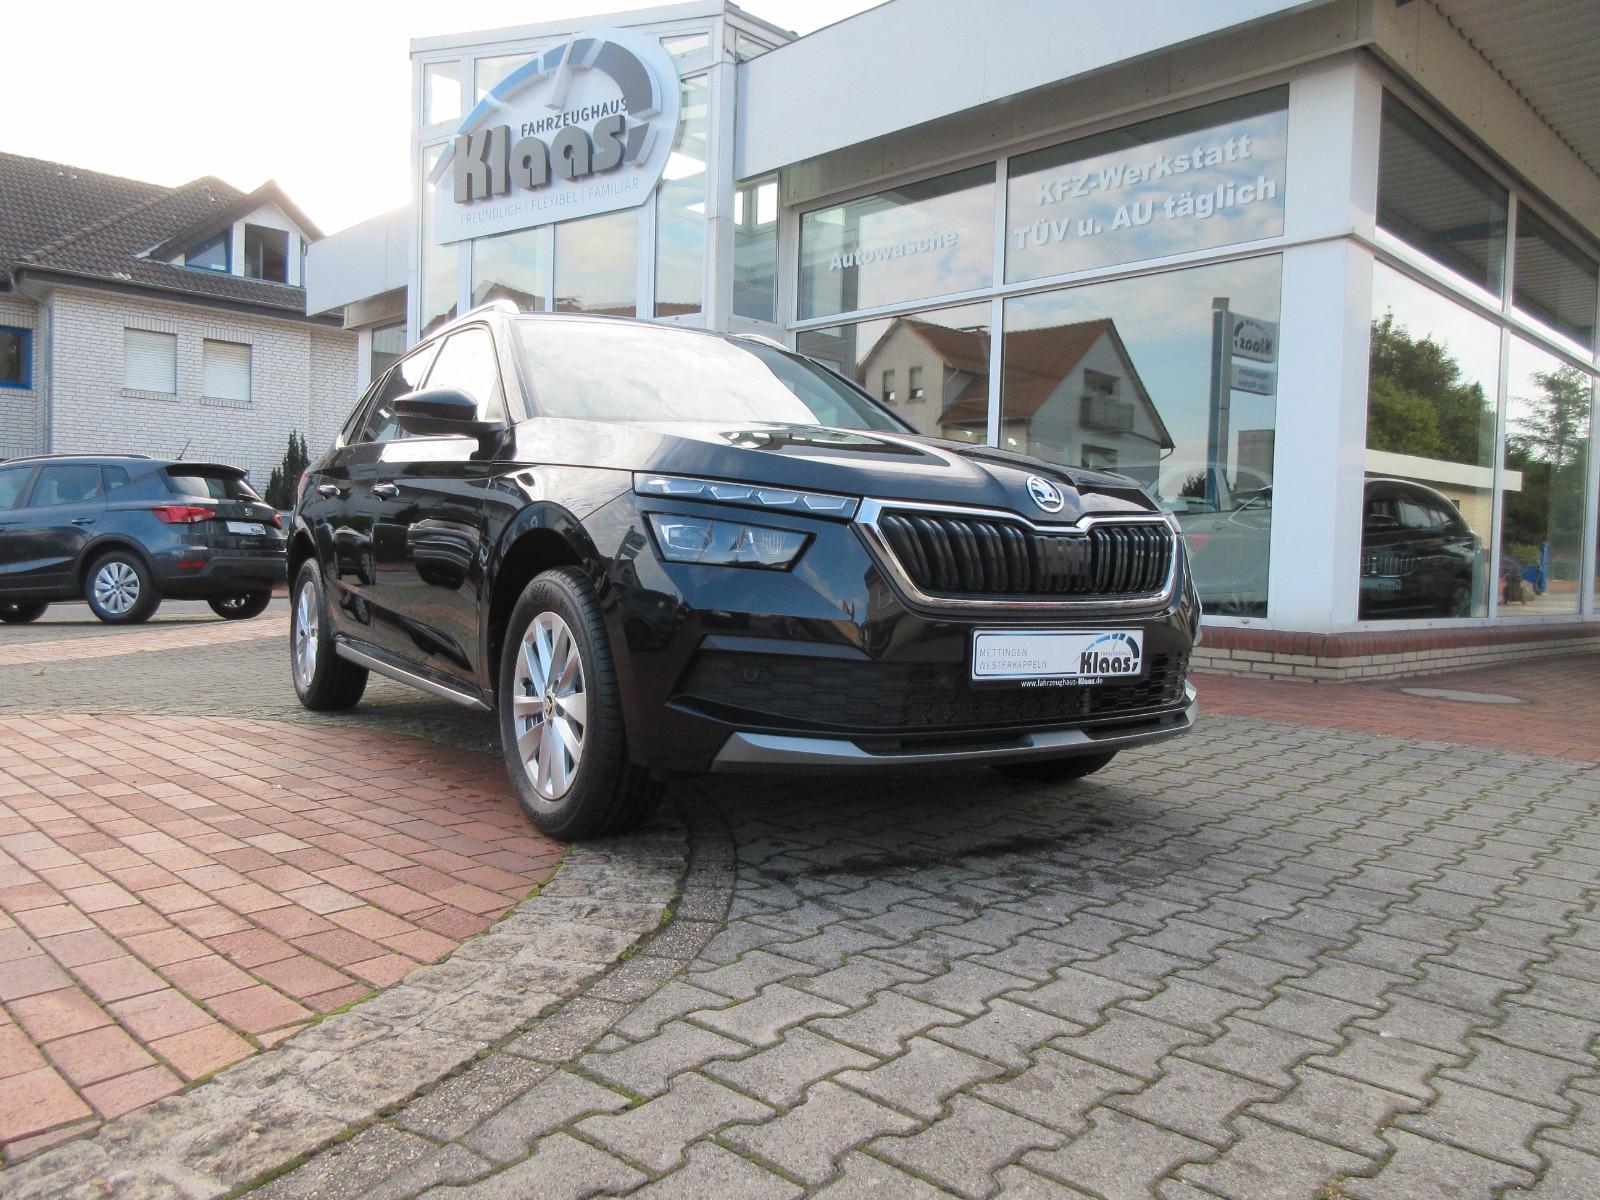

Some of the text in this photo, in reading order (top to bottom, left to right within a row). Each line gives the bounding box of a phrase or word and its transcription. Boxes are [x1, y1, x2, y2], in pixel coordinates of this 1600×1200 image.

[521, 98, 628, 138] FAHRZEUGHAUS
[454, 114, 625, 204] Klaas
[1037, 133, 1252, 206] KFZ-Werkstatt
[460, 176, 639, 226] FREUNDLICH FLEXIBEL FAMILIÄR
[1013, 175, 1276, 249] TÜV u. AU täglich
[979, 648, 1028, 657] METTINGEN
[979, 660, 1047, 670] WESTERKAPPELN
[1080, 651, 1131, 673] Klaas
[1020, 677, 1103, 688] www.fahrzeughaus-Klaas.de
